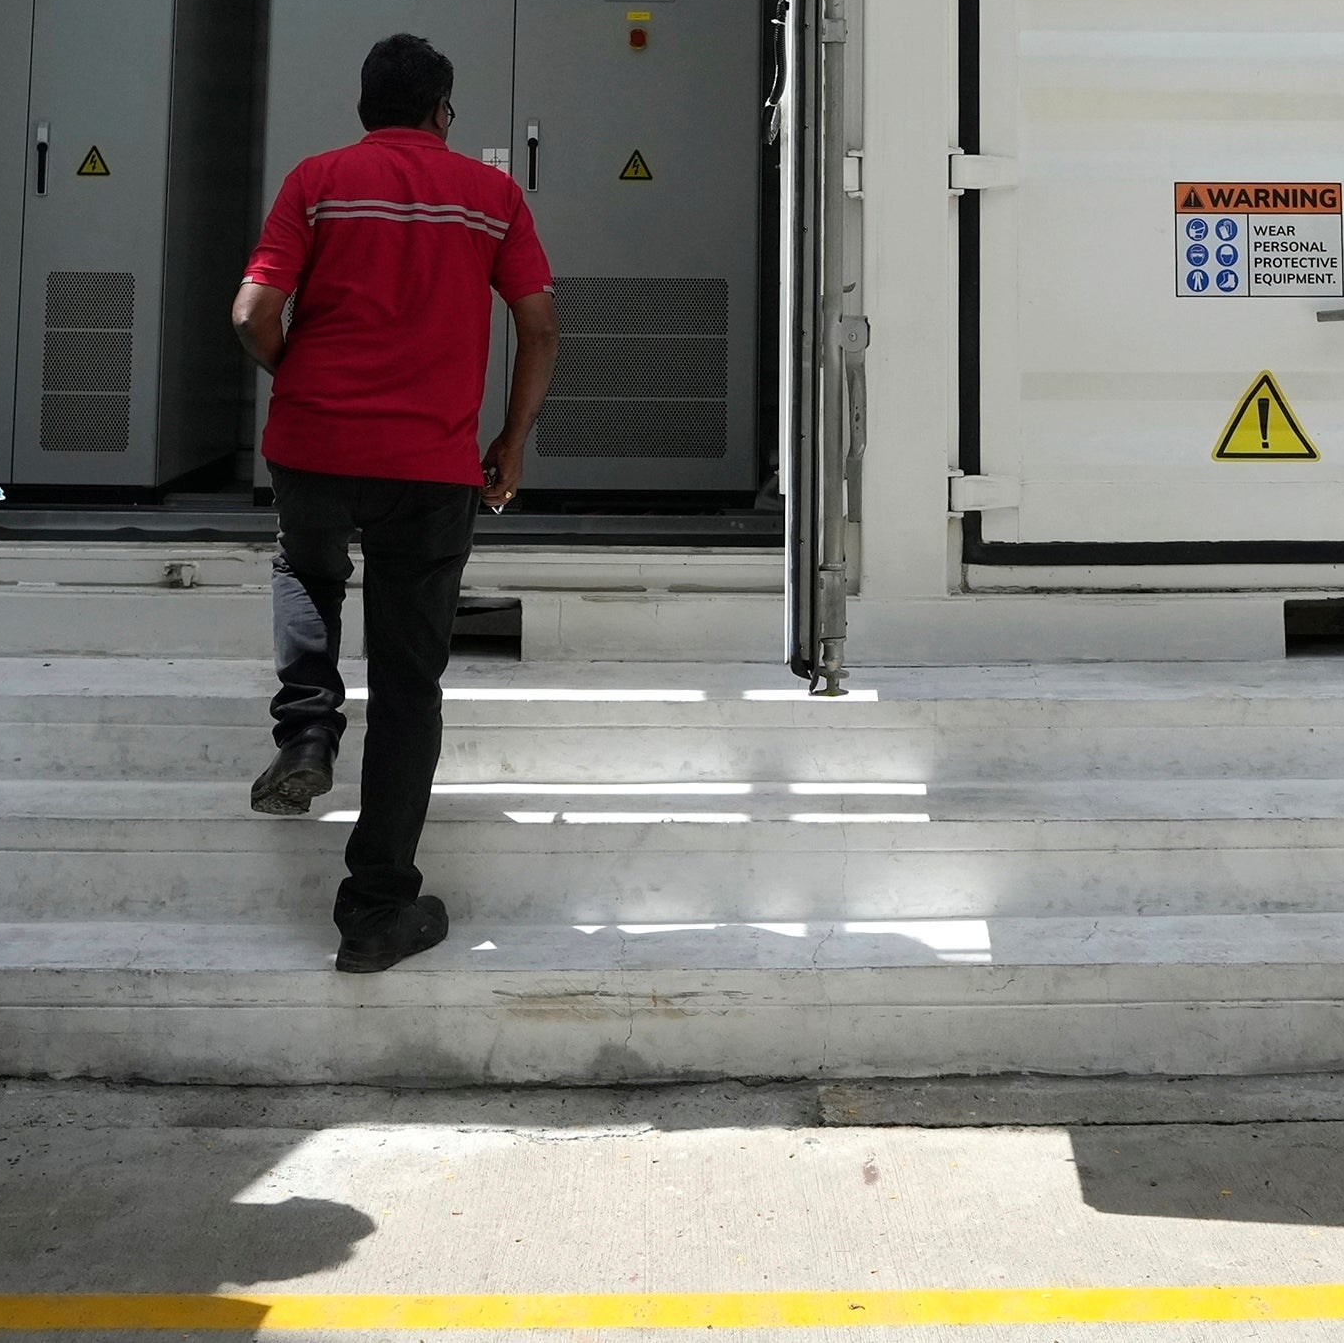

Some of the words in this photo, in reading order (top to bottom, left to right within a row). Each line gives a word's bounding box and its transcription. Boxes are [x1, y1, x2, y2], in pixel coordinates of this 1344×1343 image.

[1207, 188, 1337, 208] WARNING
[1253, 225, 1295, 236] WEAR
[1254, 242, 1327, 252] PERSONAL
[1254, 257, 1338, 268] PROTECTIVE
[1254, 273, 1336, 285] EQUIPMENT.
